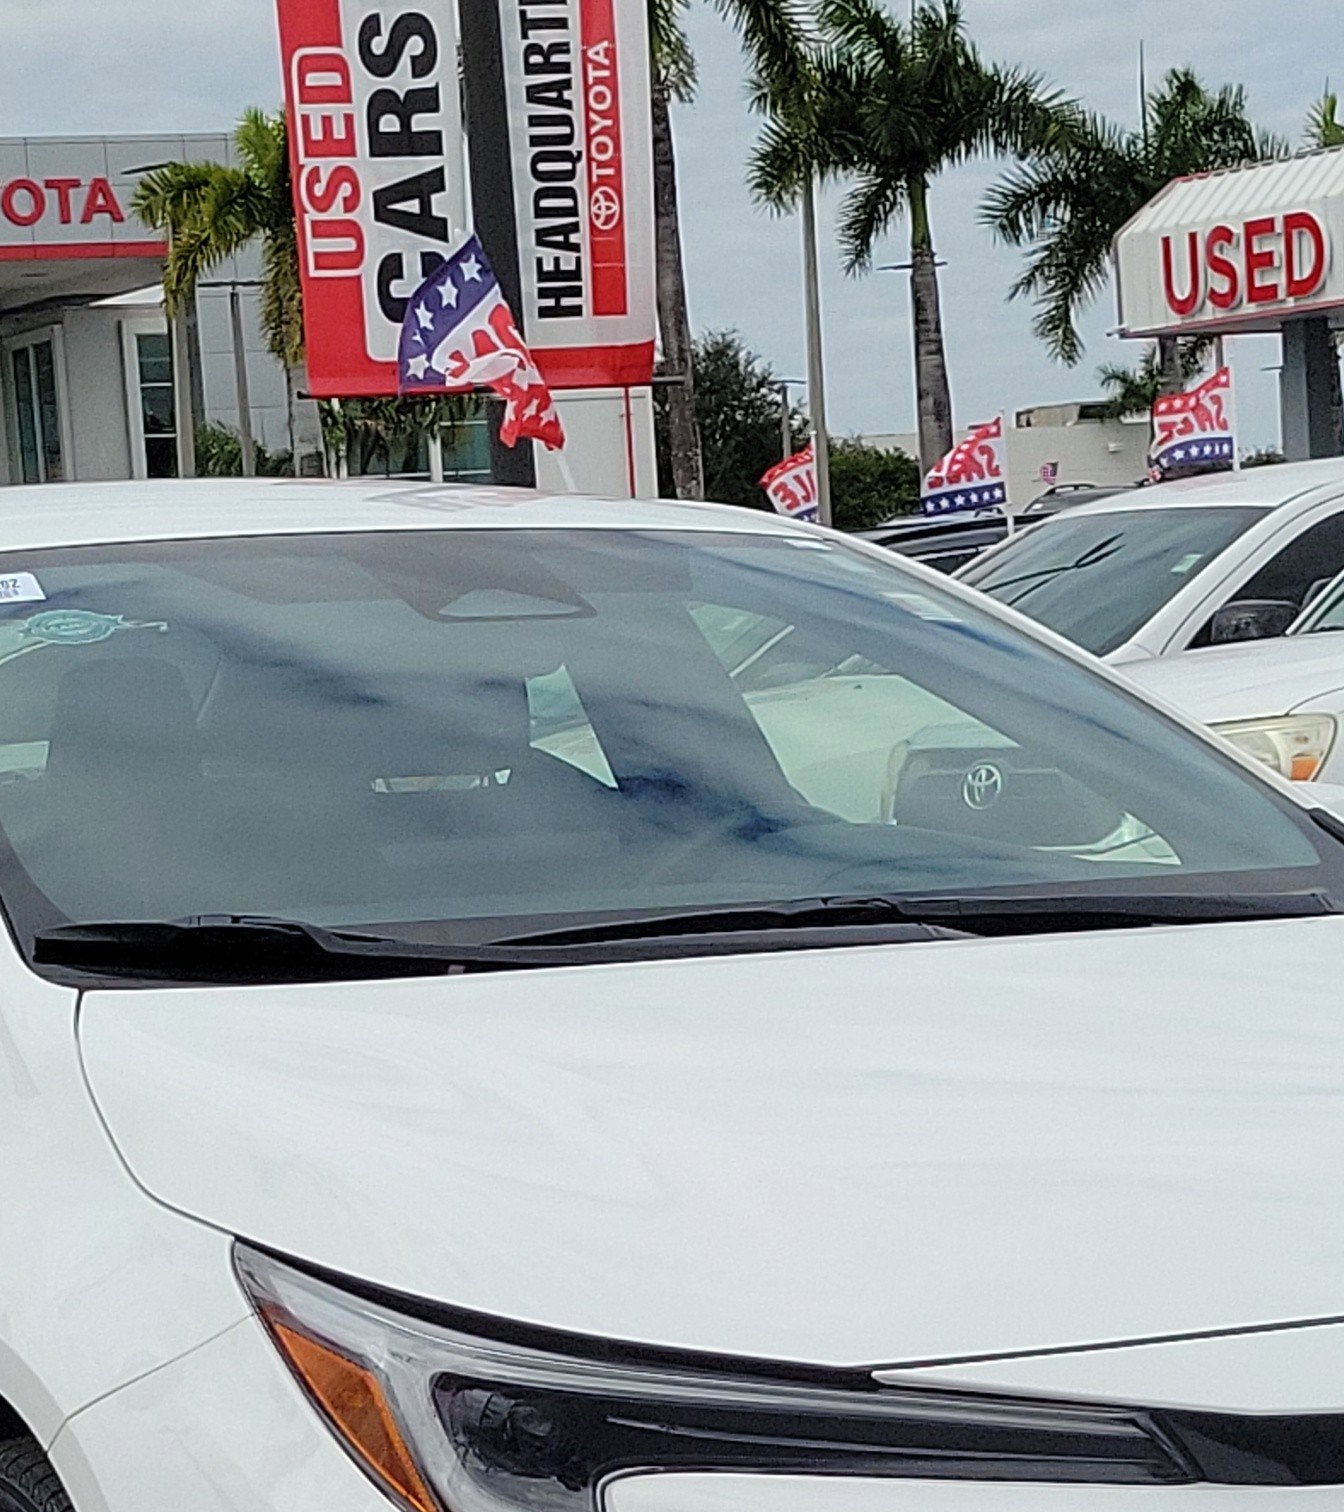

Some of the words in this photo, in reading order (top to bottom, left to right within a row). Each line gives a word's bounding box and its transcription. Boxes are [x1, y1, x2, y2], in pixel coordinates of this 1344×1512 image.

[294, 49, 365, 275] USED
[358, 12, 450, 323] CARS
[518, 0, 583, 319] HEADQUART
[587, 40, 615, 182] TOYOTA
[1161, 211, 1327, 316] USED
